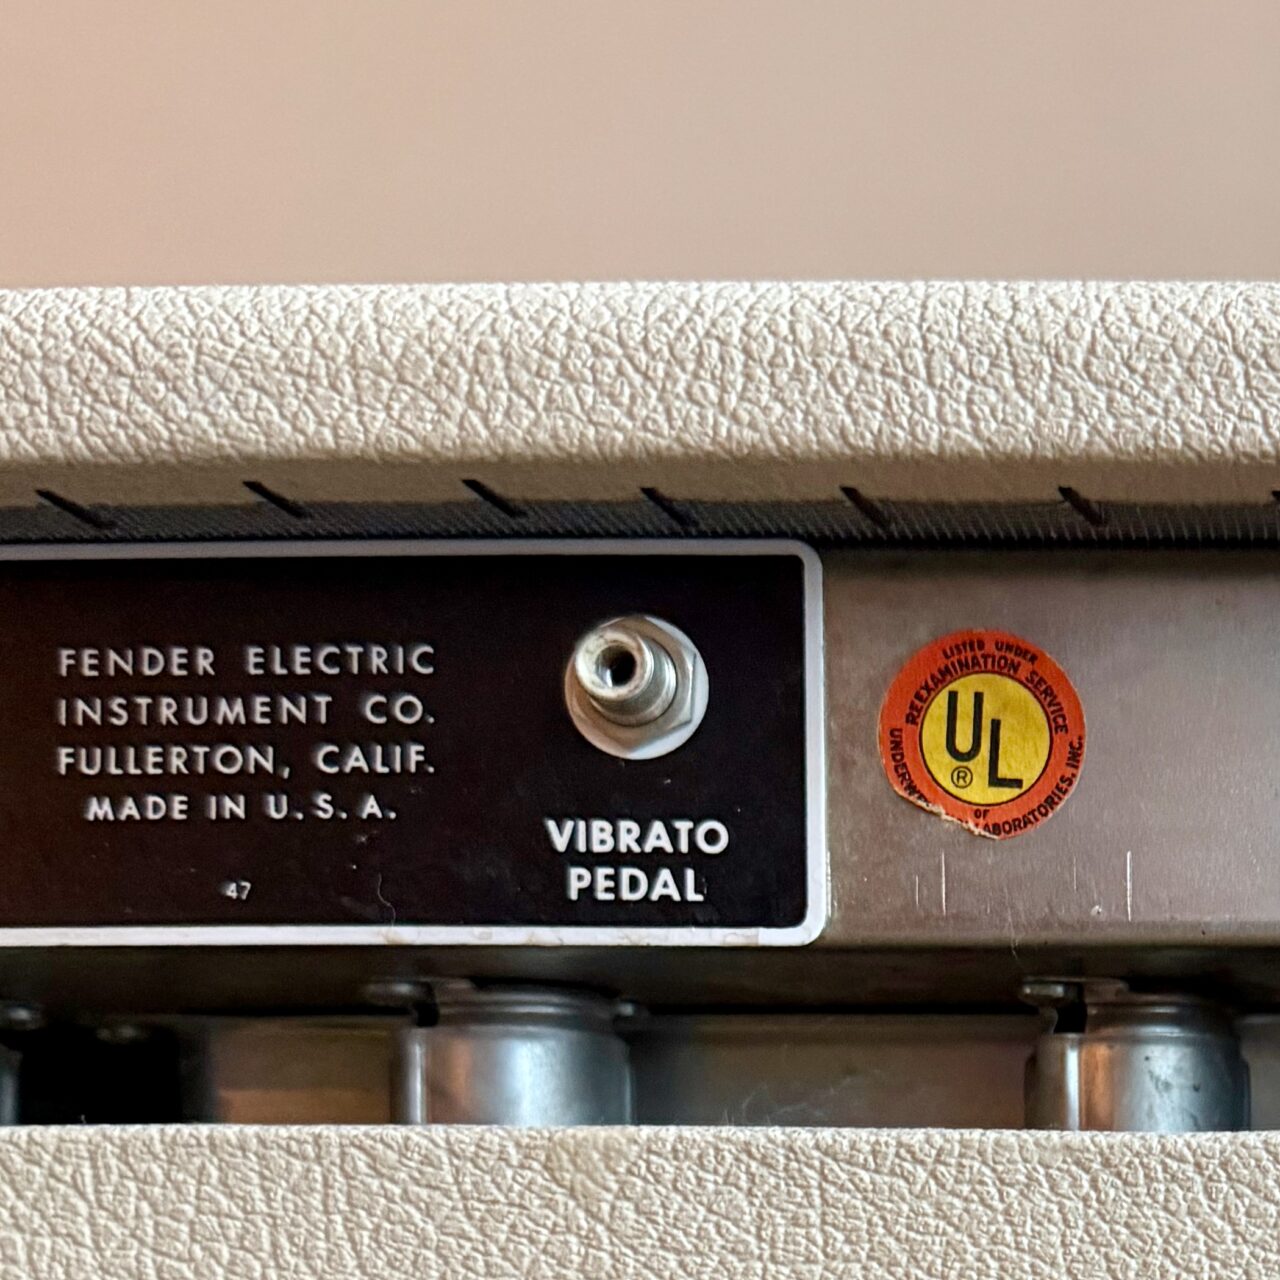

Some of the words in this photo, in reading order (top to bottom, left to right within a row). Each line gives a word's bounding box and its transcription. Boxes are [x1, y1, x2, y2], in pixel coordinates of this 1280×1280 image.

[60, 647, 215, 677] FENDER
[247, 645, 434, 675] ELECTRIC
[942, 639, 985, 660] LISTED
[995, 640, 1039, 665] UNDER
[58, 696, 332, 726] INSTRUMENT
[364, 694, 435, 724] CO.
[905, 653, 1021, 727] REEXAMINATION
[1024, 669, 1069, 735] SERVICE
[945, 690, 1024, 789] UL
[57, 745, 291, 779] FULLERTON,
[316, 744, 435, 774] CALIF.
[974, 773, 1077, 836] ABORATORIES,
[1065, 735, 1084, 769] INC.
[85, 796, 188, 821] MADE
[209, 794, 246, 820] IN
[545, 819, 730, 854] VIBRATO
[225, 881, 251, 900] 47
[568, 866, 705, 902] PEDAL
